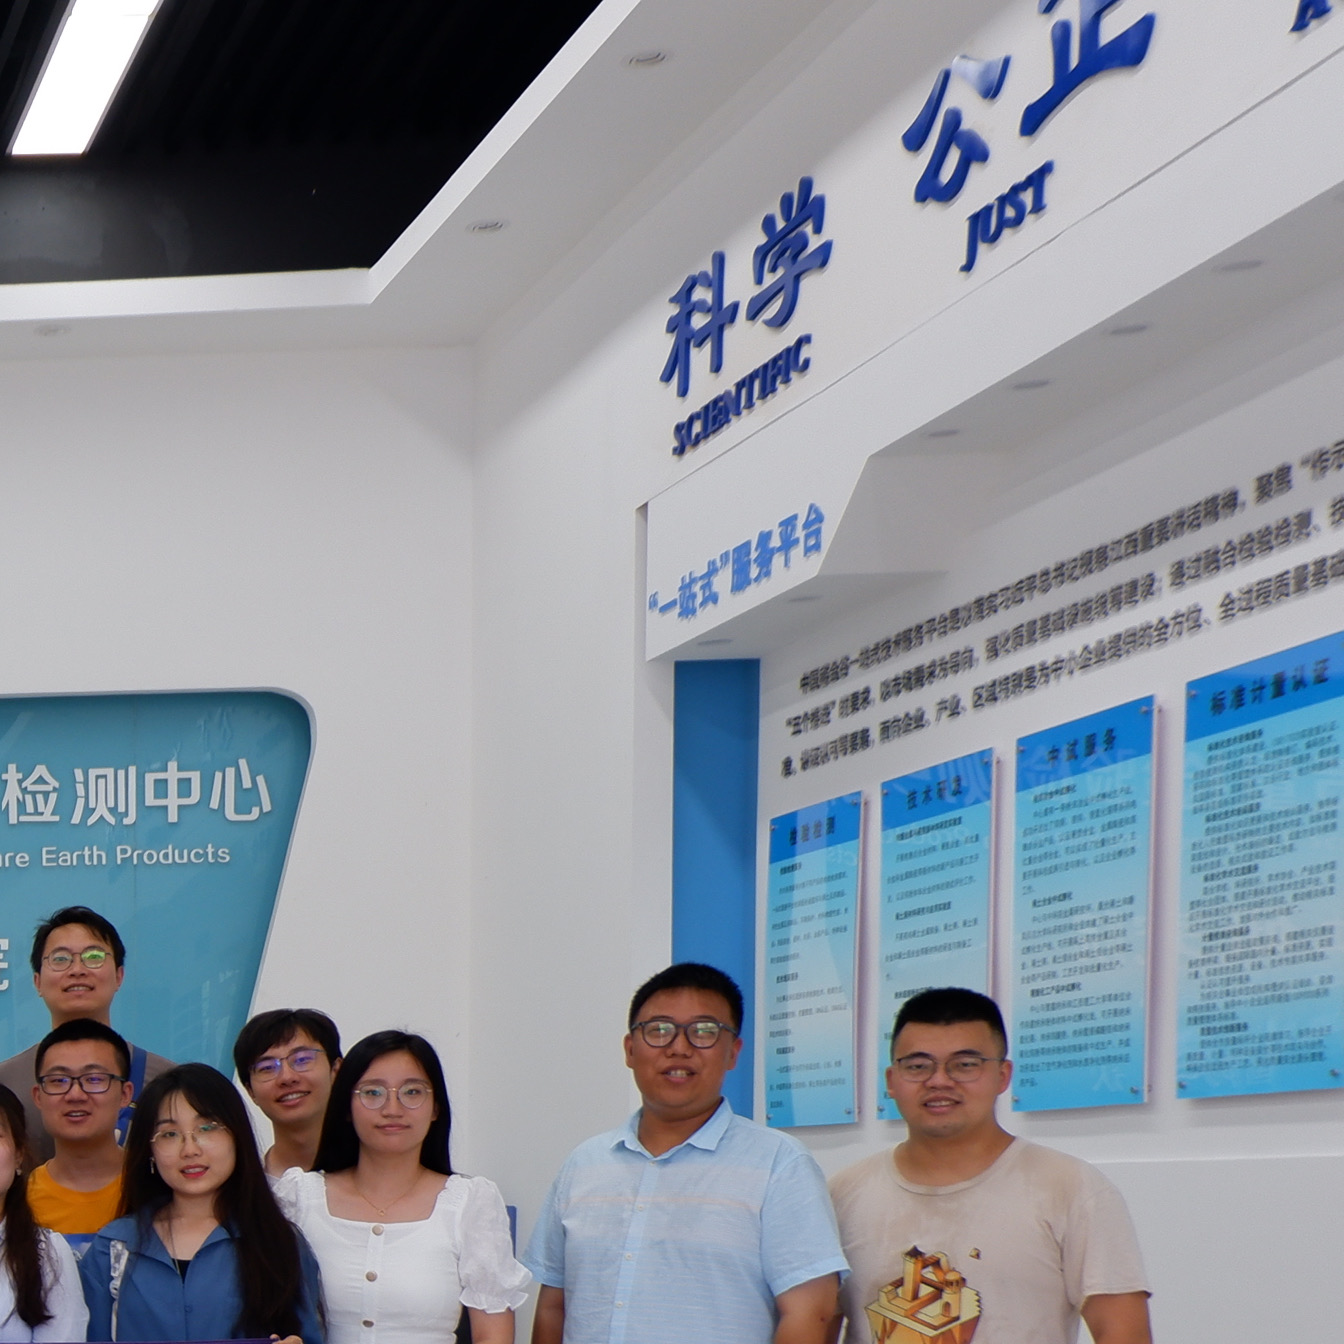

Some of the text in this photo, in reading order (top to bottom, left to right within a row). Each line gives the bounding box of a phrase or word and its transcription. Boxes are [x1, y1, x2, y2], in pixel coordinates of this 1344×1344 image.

[960, 160, 1054, 272] JUST
[659, 176, 834, 398] 科学
[672, 333, 812, 456] SCIENTIFIC
[41, 845, 107, 866] Earth
[116, 843, 231, 865] Products
